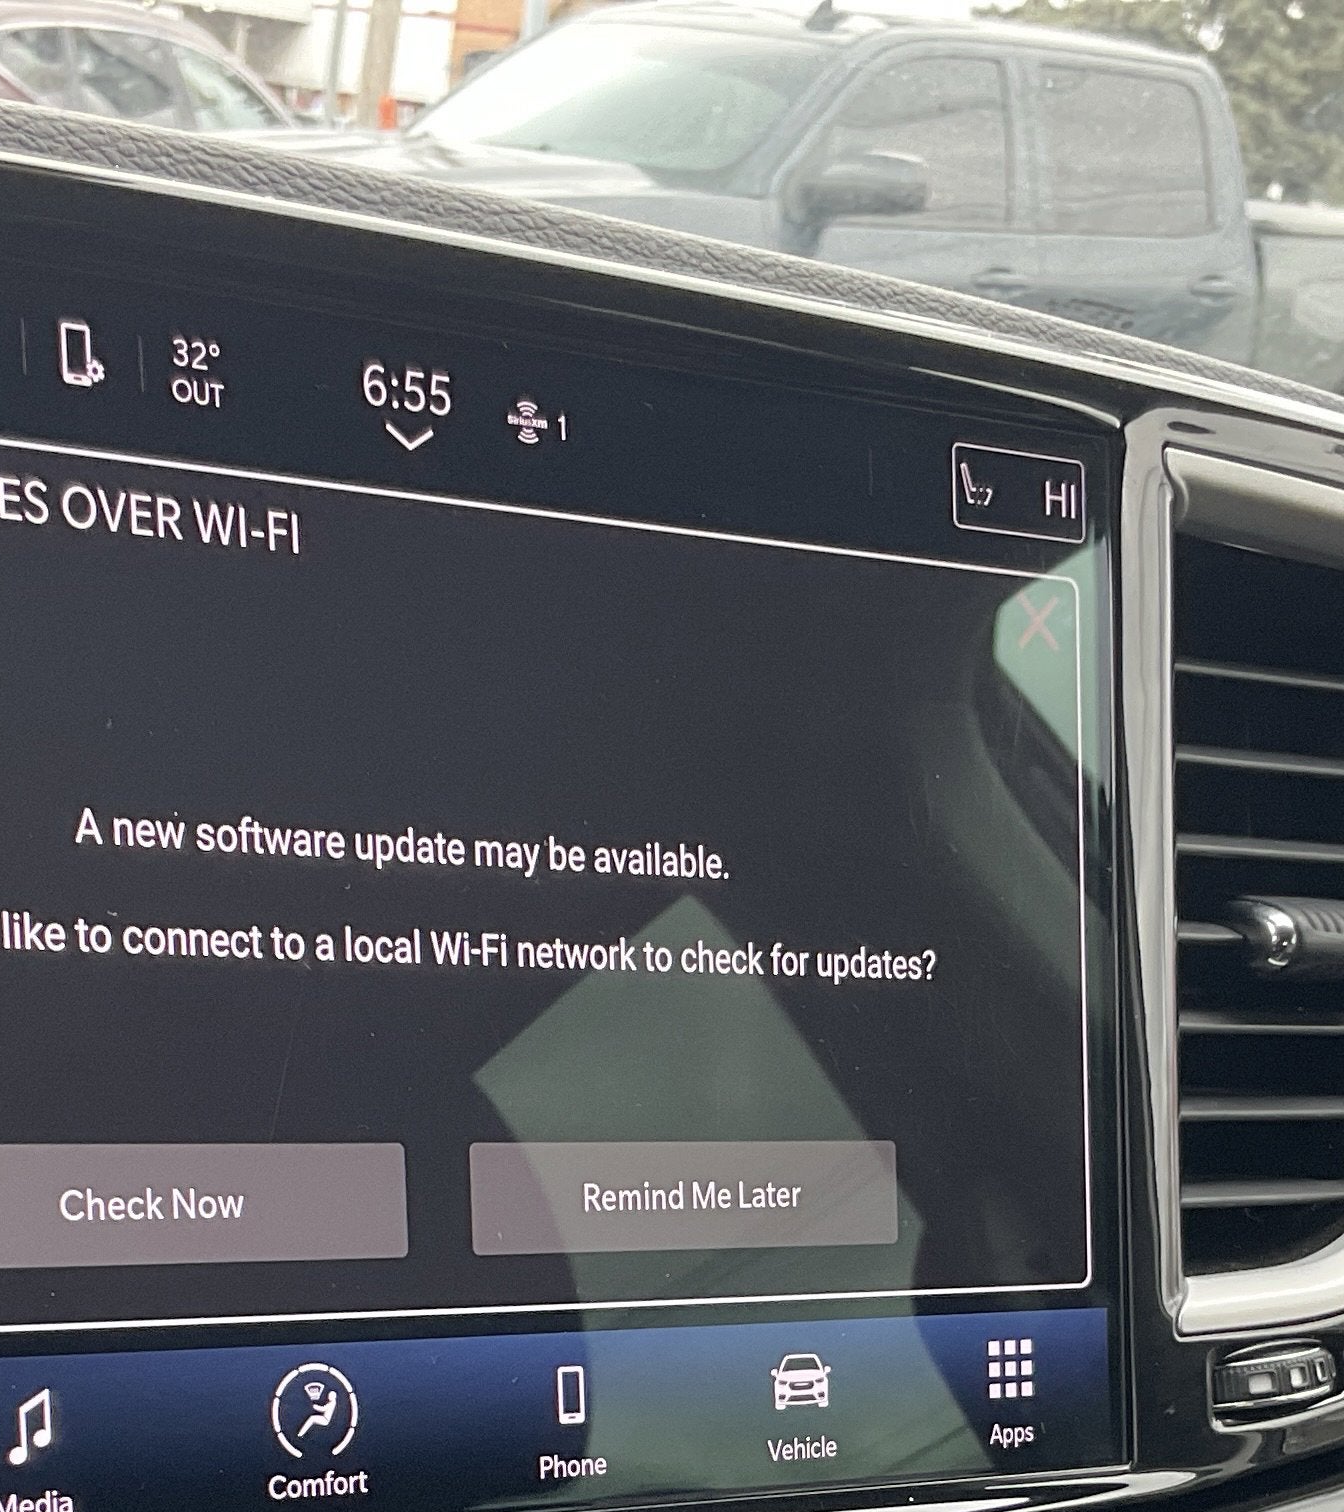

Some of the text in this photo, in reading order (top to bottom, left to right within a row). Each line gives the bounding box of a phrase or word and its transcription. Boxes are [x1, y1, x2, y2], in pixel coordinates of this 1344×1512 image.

[171, 378, 225, 408] OUT
[363, 364, 451, 416] 6:55
[557, 415, 567, 441] 1
[1045, 480, 1076, 519] HI
[61, 484, 184, 541] OVER
[192, 499, 300, 554] WI-FI
[75, 807, 730, 880] A new software update may be available.
[1, 910, 66, 952] like
[73, 918, 112, 954] to
[122, 925, 264, 959] connect
[269, 926, 306, 961] to
[315, 934, 335, 962] a
[344, 925, 421, 964] local
[430, 930, 508, 967] Wi-Fi
[517, 936, 638, 971] network
[642, 941, 673, 973] to
[680, 939, 765, 975] check
[769, 942, 810, 977] for
[816, 945, 936, 986] updates?
[59, 1187, 244, 1221] Check Now
[583, 1180, 802, 1213] Remind Me Later
[767, 1435, 838, 1462] Vehicle
[989, 1423, 1035, 1449] Apps
[539, 1454, 608, 1480] Phone
[268, 1469, 369, 1500] Comfort
